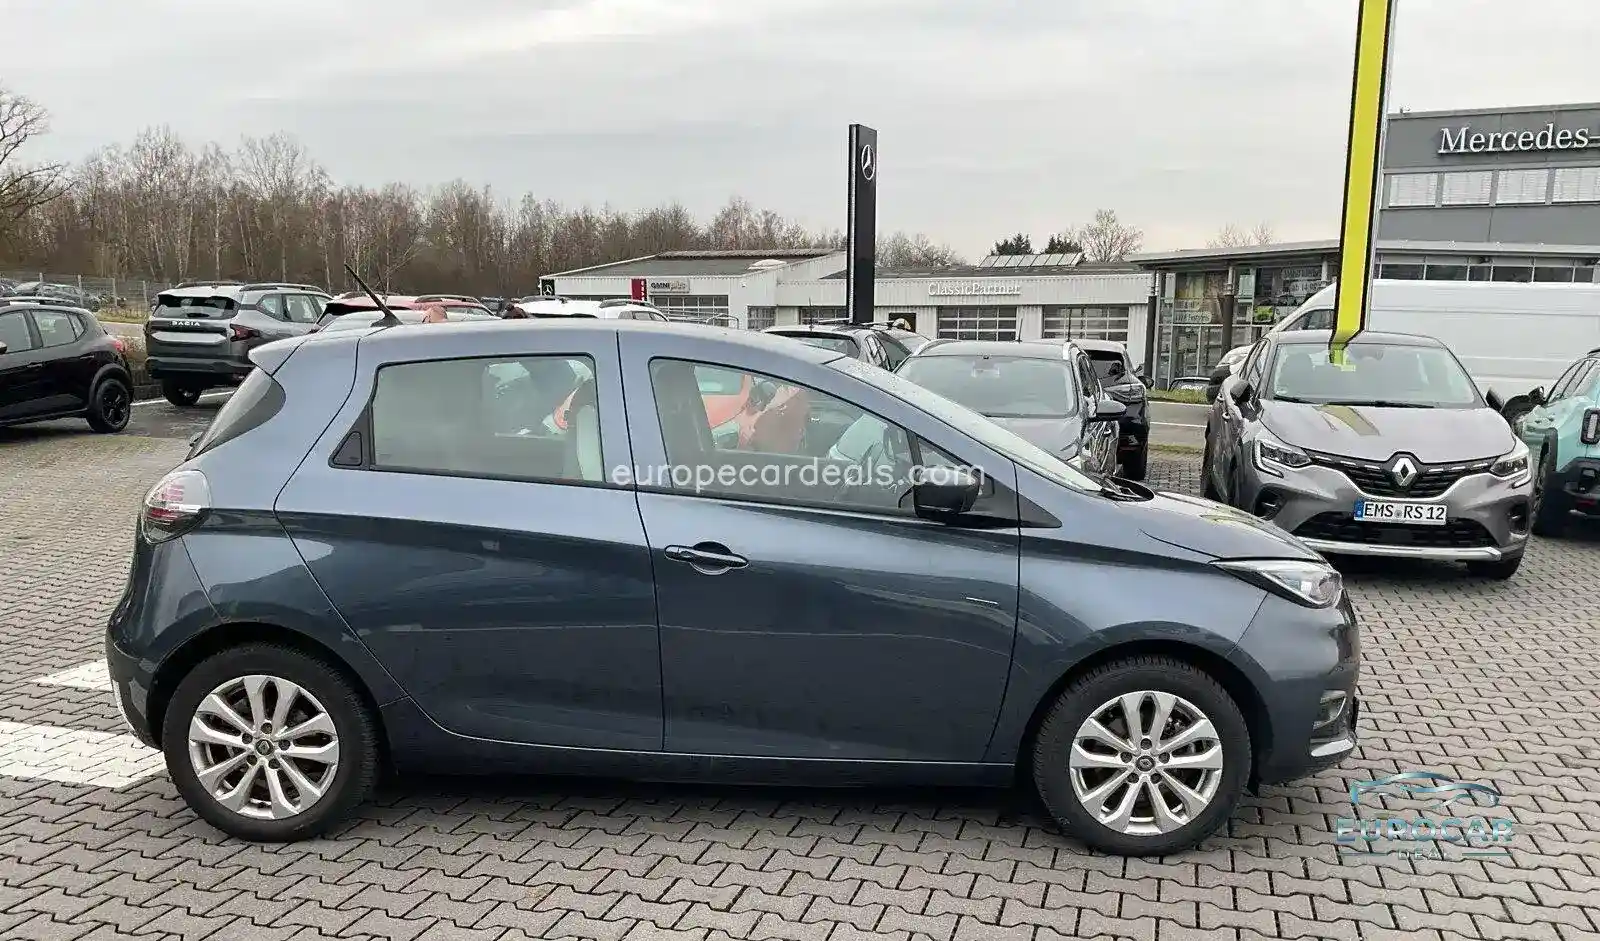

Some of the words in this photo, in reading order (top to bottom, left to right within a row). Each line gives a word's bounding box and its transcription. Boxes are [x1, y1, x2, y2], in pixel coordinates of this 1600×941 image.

[1363, 503, 1394, 518] EMS
[1403, 505, 1424, 519] RS
[1426, 506, 1446, 520] 12
